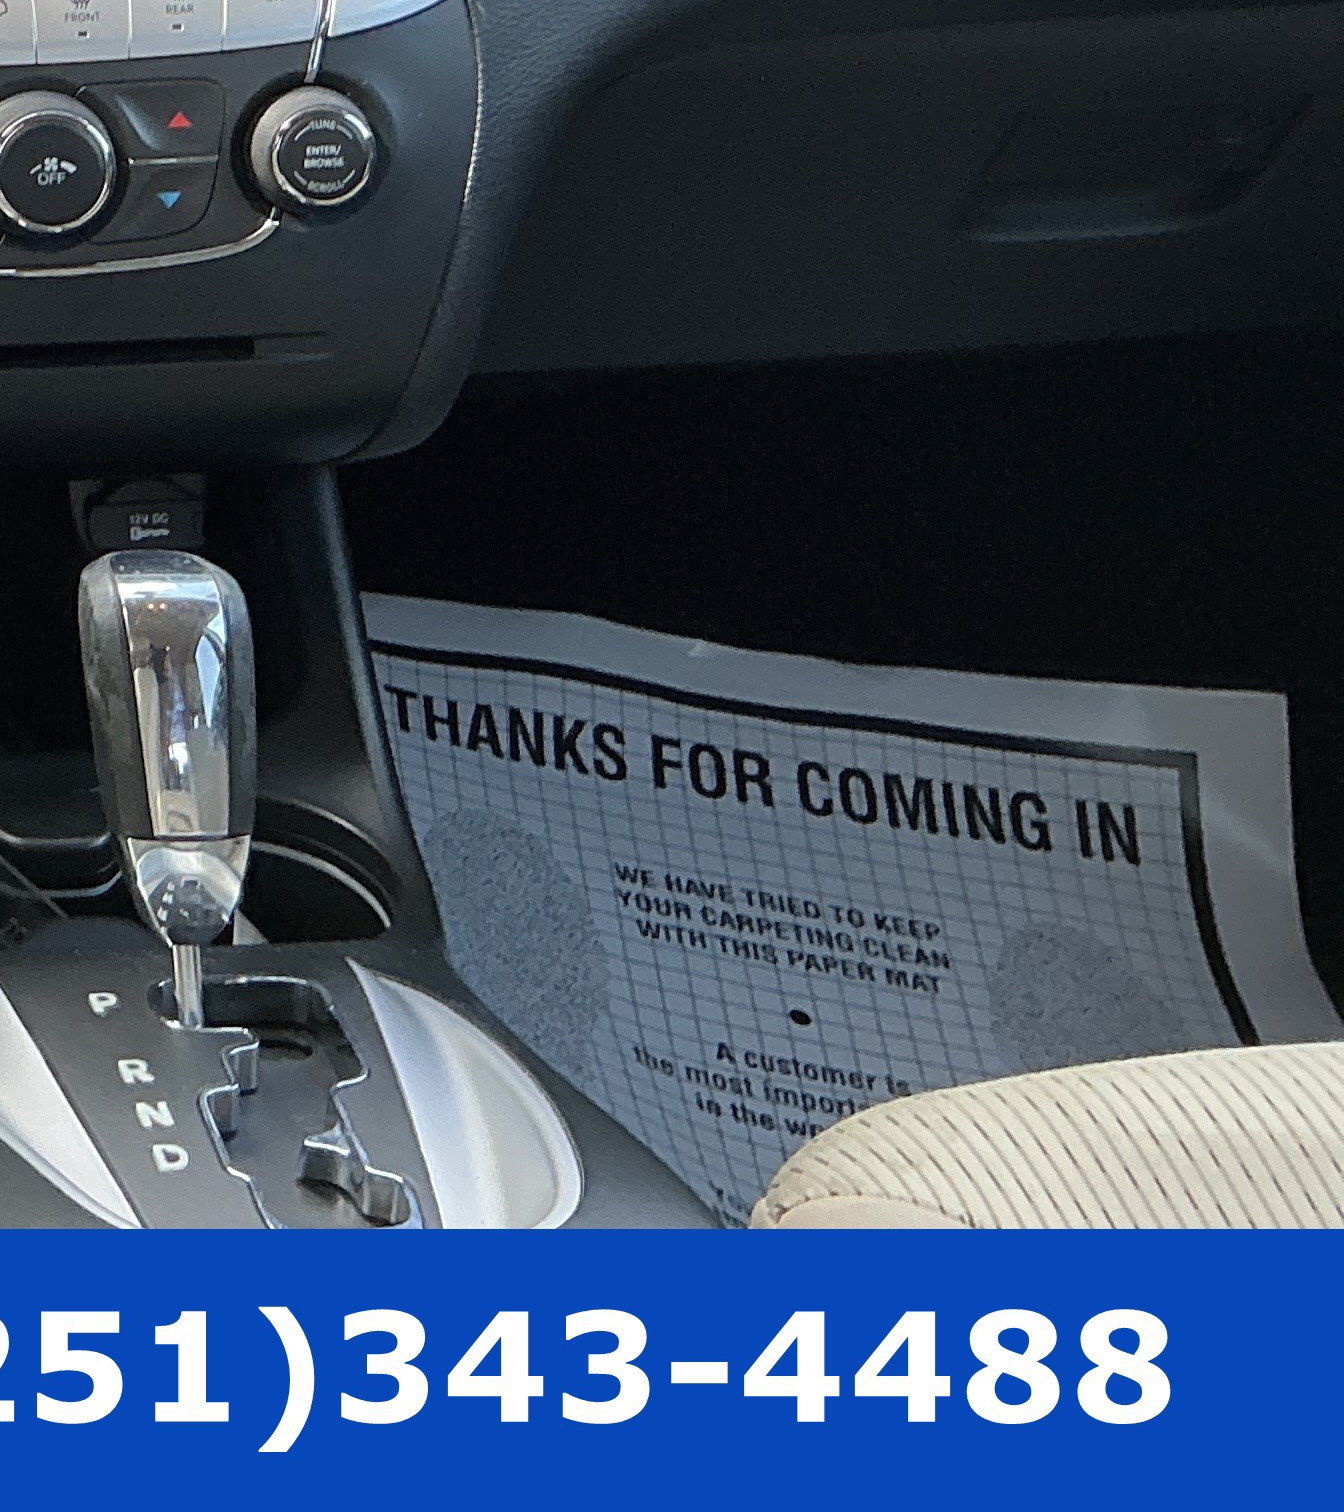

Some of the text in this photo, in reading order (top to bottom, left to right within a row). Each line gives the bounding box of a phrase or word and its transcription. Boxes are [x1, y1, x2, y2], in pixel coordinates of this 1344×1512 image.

[64, 12, 101, 24] FRONT
[165, 4, 195, 15] REAR
[37, 172, 67, 186] OFF
[384, 684, 1141, 866] THANKS FOR COMING IN
[614, 863, 940, 940] WE HAVE TRIED TO KEEP
[616, 889, 950, 970] YOUR CARPETING CLEAN
[635, 918, 940, 993] WITH THIS PAPER MAT
[88, 992, 118, 1016] P
[118, 1059, 155, 1085] R
[632, 1045, 869, 1116] the most import
[716, 1042, 736, 1064] A
[744, 1050, 876, 1092] customer
[135, 1100, 175, 1128] N
[730, 1102, 775, 1131] the
[152, 1144, 189, 1173] D
